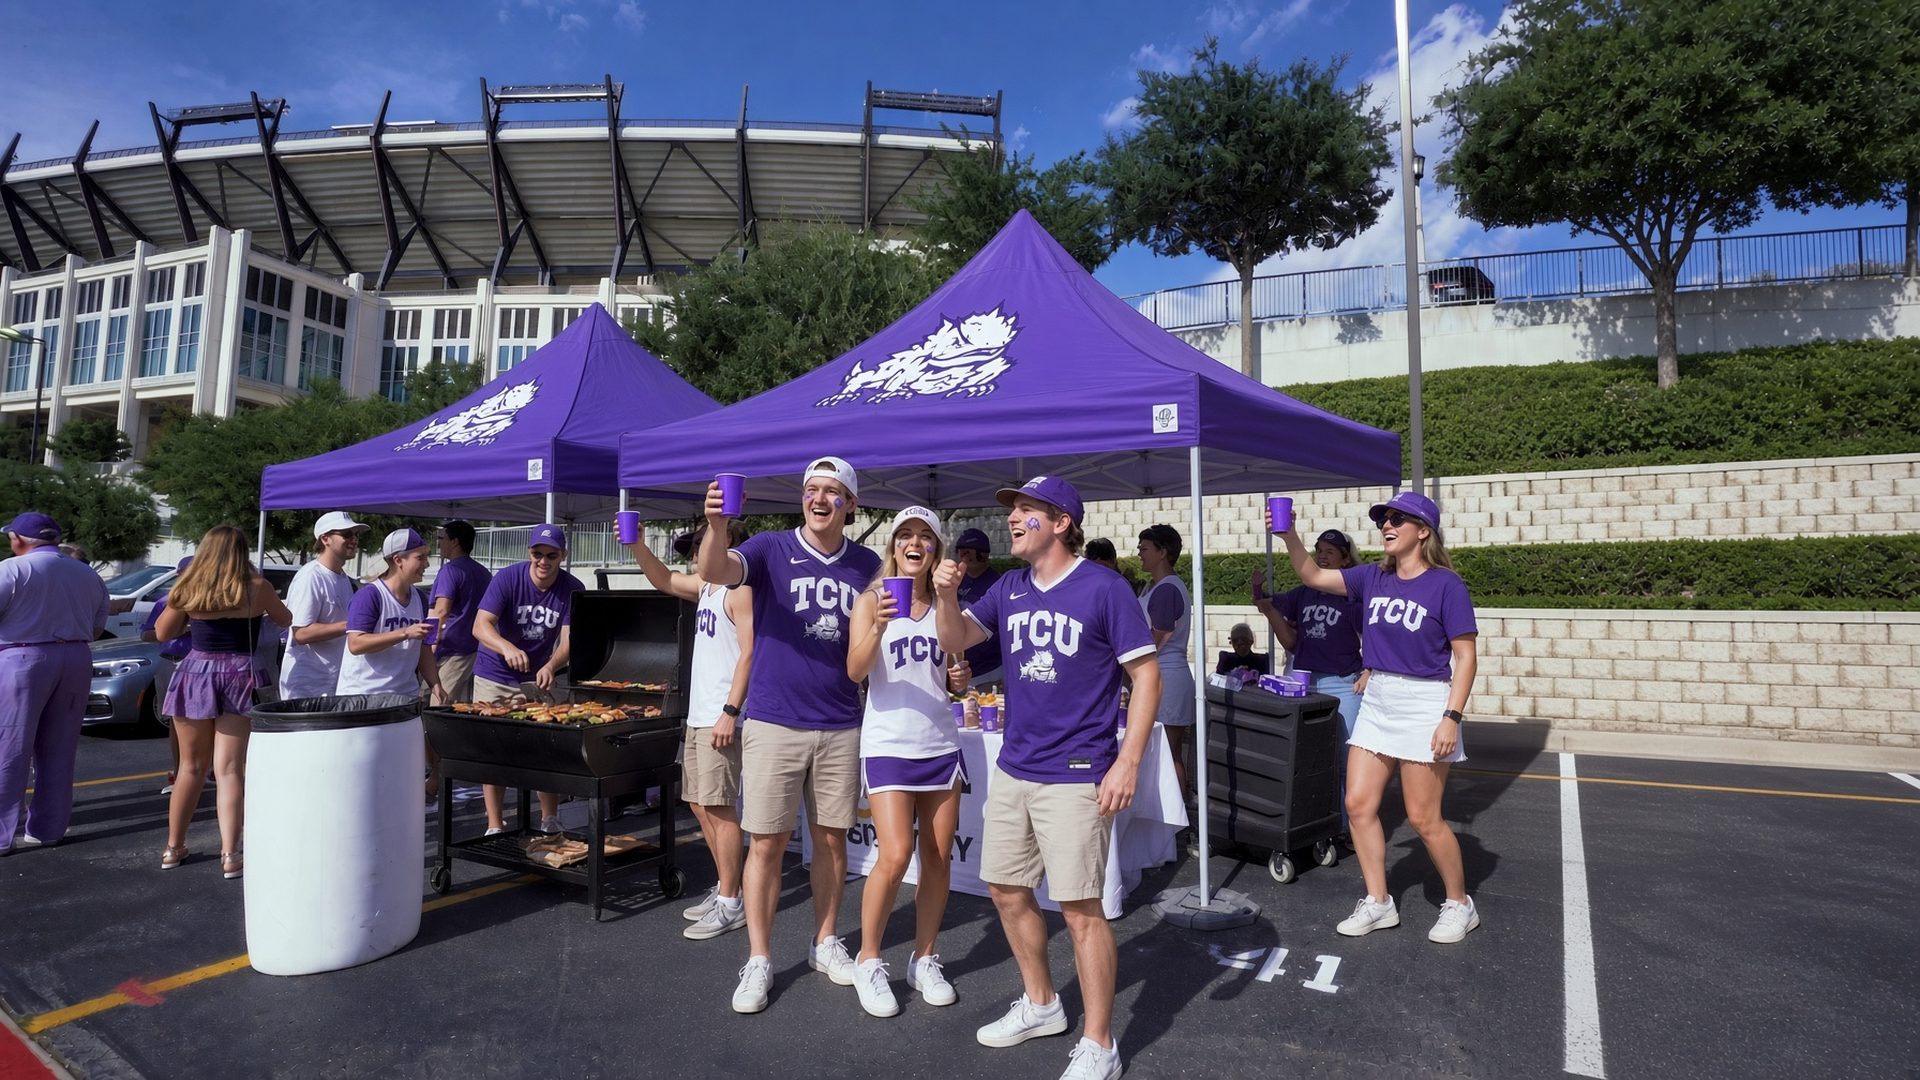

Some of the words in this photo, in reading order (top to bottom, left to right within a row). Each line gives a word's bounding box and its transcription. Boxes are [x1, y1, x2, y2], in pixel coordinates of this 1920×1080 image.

[789, 576, 860, 618] TCU
[1368, 597, 1428, 632] TCU
[517, 604, 560, 629] TCU
[1007, 610, 1083, 657] TCU
[1302, 605, 1342, 627] TCU
[889, 635, 945, 670] TCU
